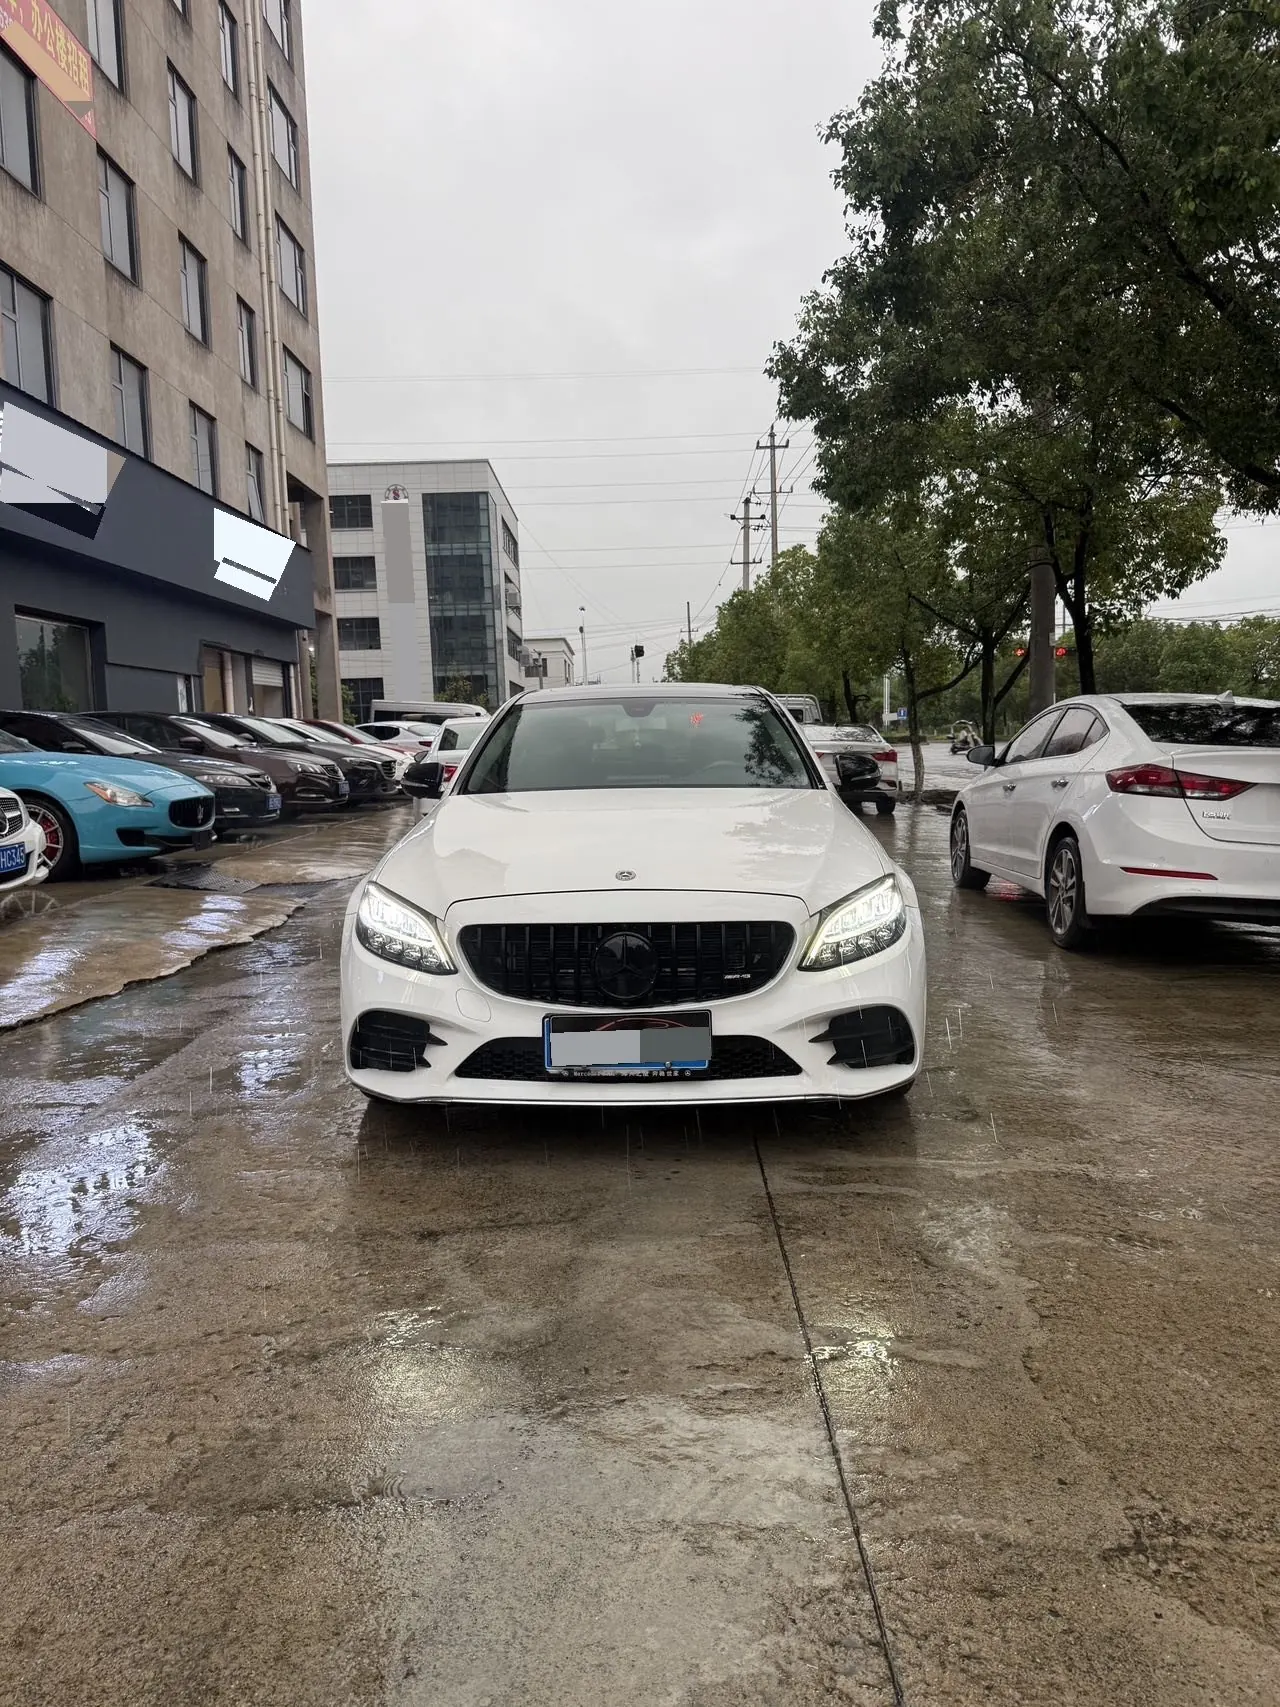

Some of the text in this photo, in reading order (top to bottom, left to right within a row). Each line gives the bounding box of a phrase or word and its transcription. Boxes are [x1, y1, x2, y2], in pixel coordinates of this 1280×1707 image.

[6, 0, 90, 96] 、办公楼招租
